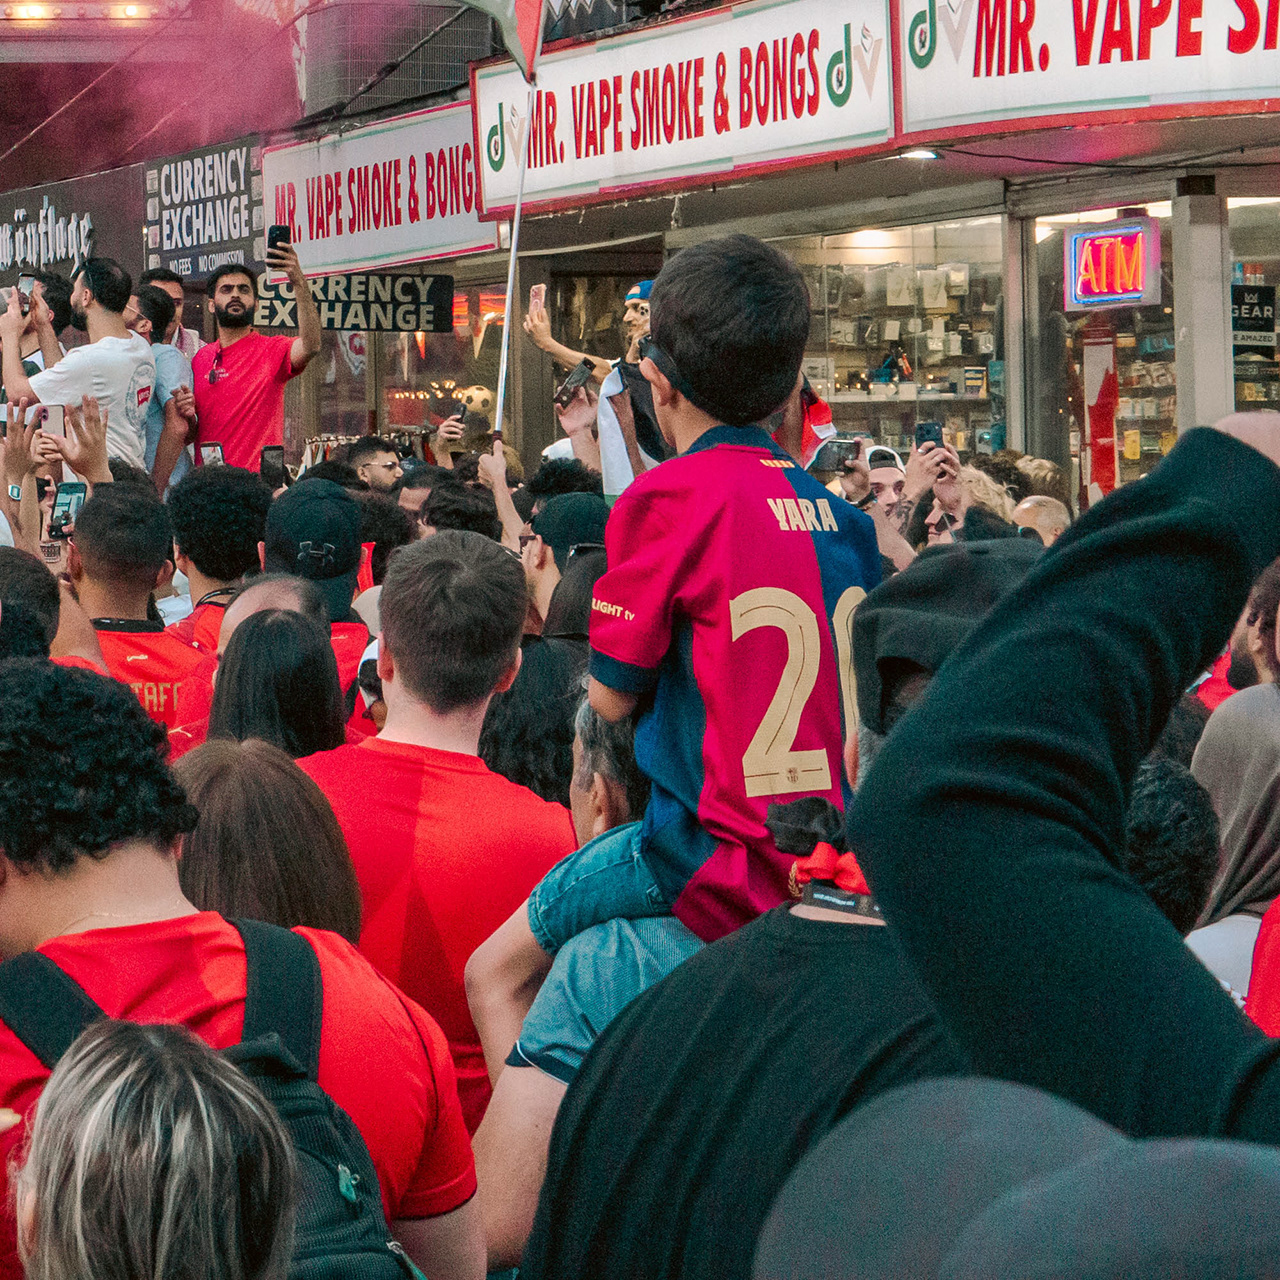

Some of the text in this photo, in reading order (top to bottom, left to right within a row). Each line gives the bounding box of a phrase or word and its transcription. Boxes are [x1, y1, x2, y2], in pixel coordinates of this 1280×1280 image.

[527, 28, 820, 169] MR. VAPE SMOKE & BONGS
[160, 147, 247, 206] CURRENCY
[275, 142, 477, 244] MR. VAPE SMOKE & BONG
[162, 194, 250, 251] EXCHANGE
[257, 272, 434, 303] CURRENCY
[1077, 232, 1143, 295] ATM
[254, 300, 434, 331] EXHANGE
[1240, 334, 1273, 342] AMAZED
[591, 597, 623, 618] LIGHT
